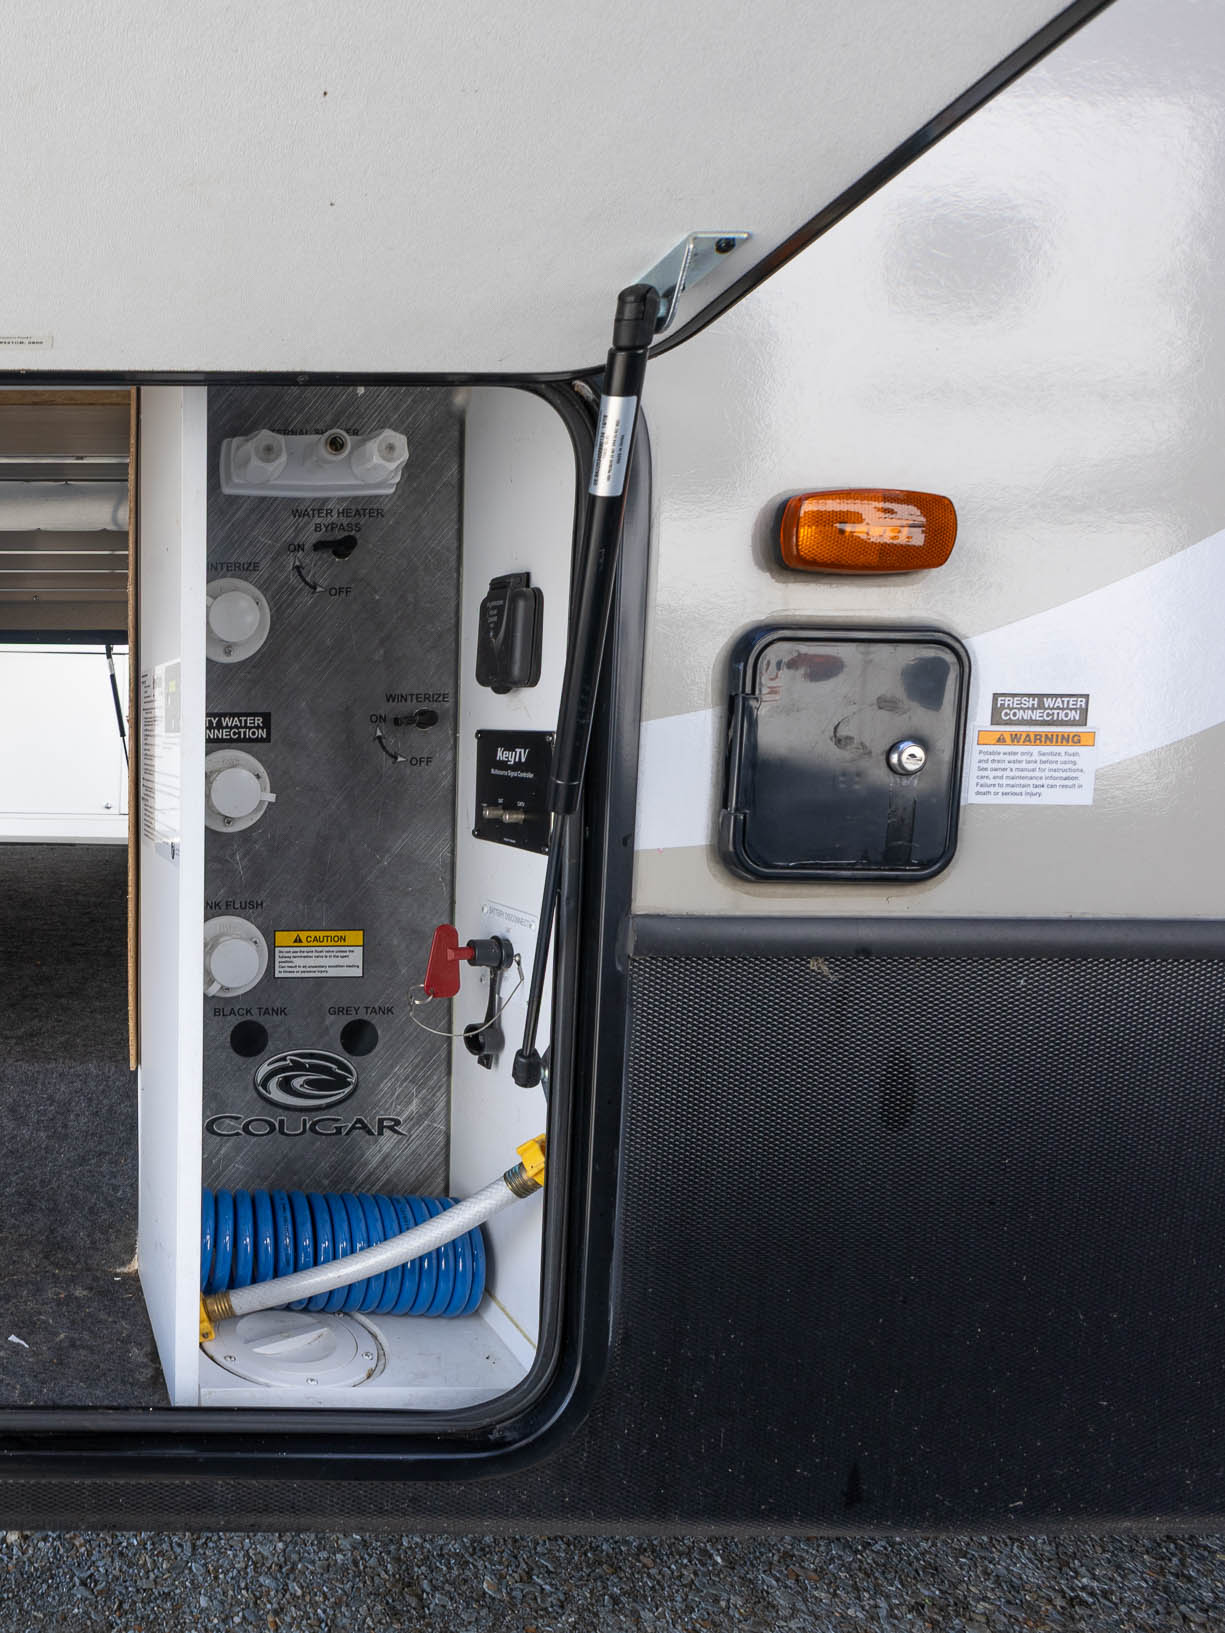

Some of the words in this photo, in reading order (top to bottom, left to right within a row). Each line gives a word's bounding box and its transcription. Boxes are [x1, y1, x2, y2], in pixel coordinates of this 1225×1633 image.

[292, 508, 333, 518] WATER
[337, 508, 385, 518] HEATER
[314, 523, 362, 532] BYPASS
[287, 543, 305, 552] ON
[328, 587, 352, 597] OFF
[385, 692, 450, 703] WINTERIZE
[997, 697, 1037, 708] FRESH
[1044, 697, 1086, 708] WATER
[369, 714, 387, 723] ON
[1001, 709, 1080, 720] CONNECTION
[205, 717, 219, 727] TY
[221, 717, 263, 727] WATER
[206, 729, 267, 739] NNECTION
[1009, 733, 1081, 744] WARNING
[409, 756, 433, 766] OFF
[496, 747, 529, 765] KeyTV
[205, 900, 222, 911] NK
[225, 900, 264, 911] FLUSH
[305, 935, 347, 943] CAUTION
[213, 1007, 253, 1017] BLACK
[257, 1007, 288, 1017] TANK
[328, 1006, 361, 1016] GREY
[364, 1006, 395, 1016] TANK
[204, 1113, 408, 1138] COUGAR
